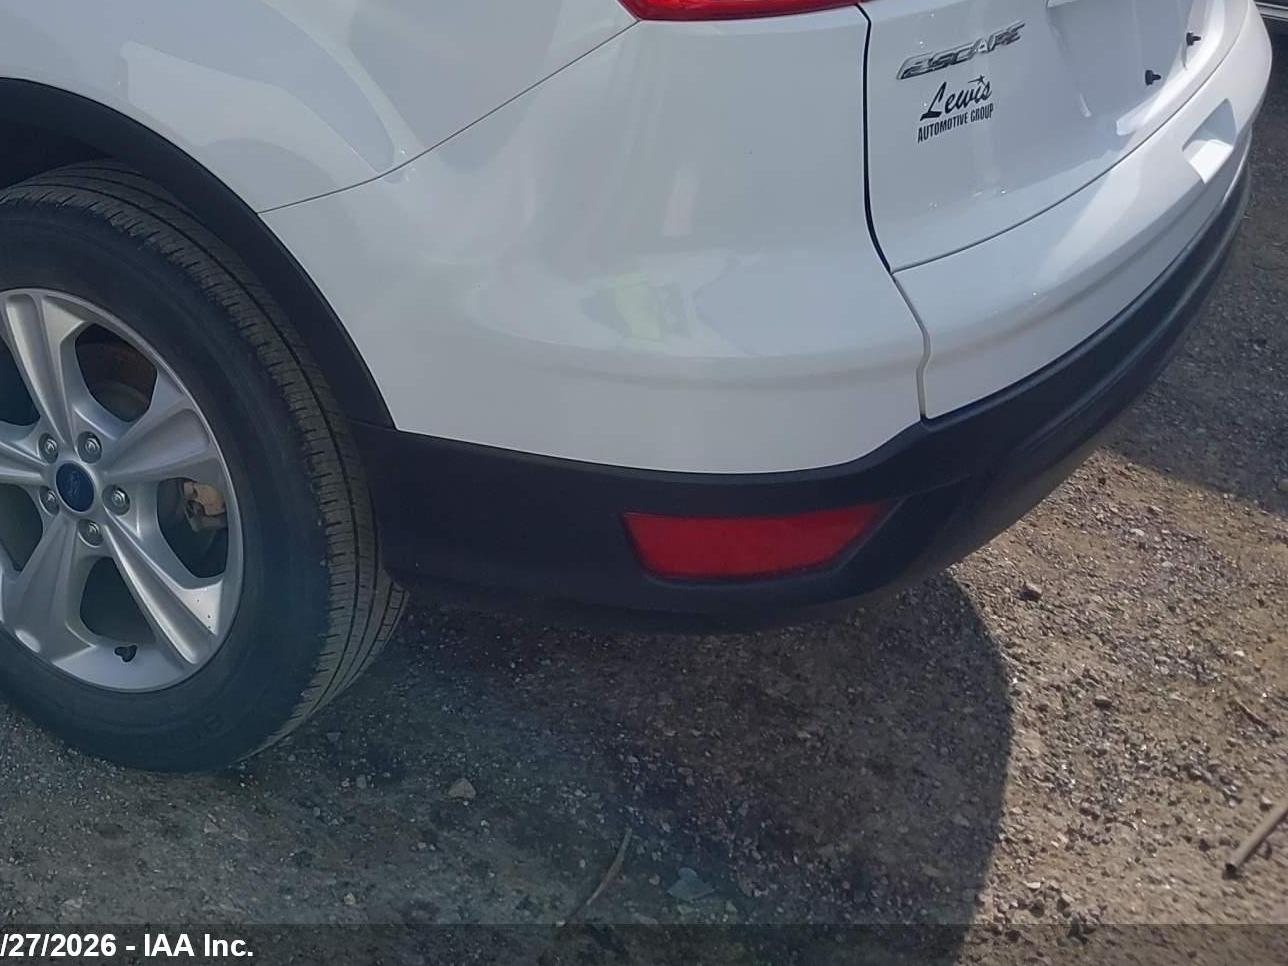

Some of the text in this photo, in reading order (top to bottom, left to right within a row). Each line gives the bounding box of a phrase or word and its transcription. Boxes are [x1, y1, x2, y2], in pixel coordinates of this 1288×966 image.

[896, 19, 1025, 80] ESCAPE
[919, 75, 993, 122] Lewis
[917, 102, 994, 144] AUTOMOTIVE GROUP
